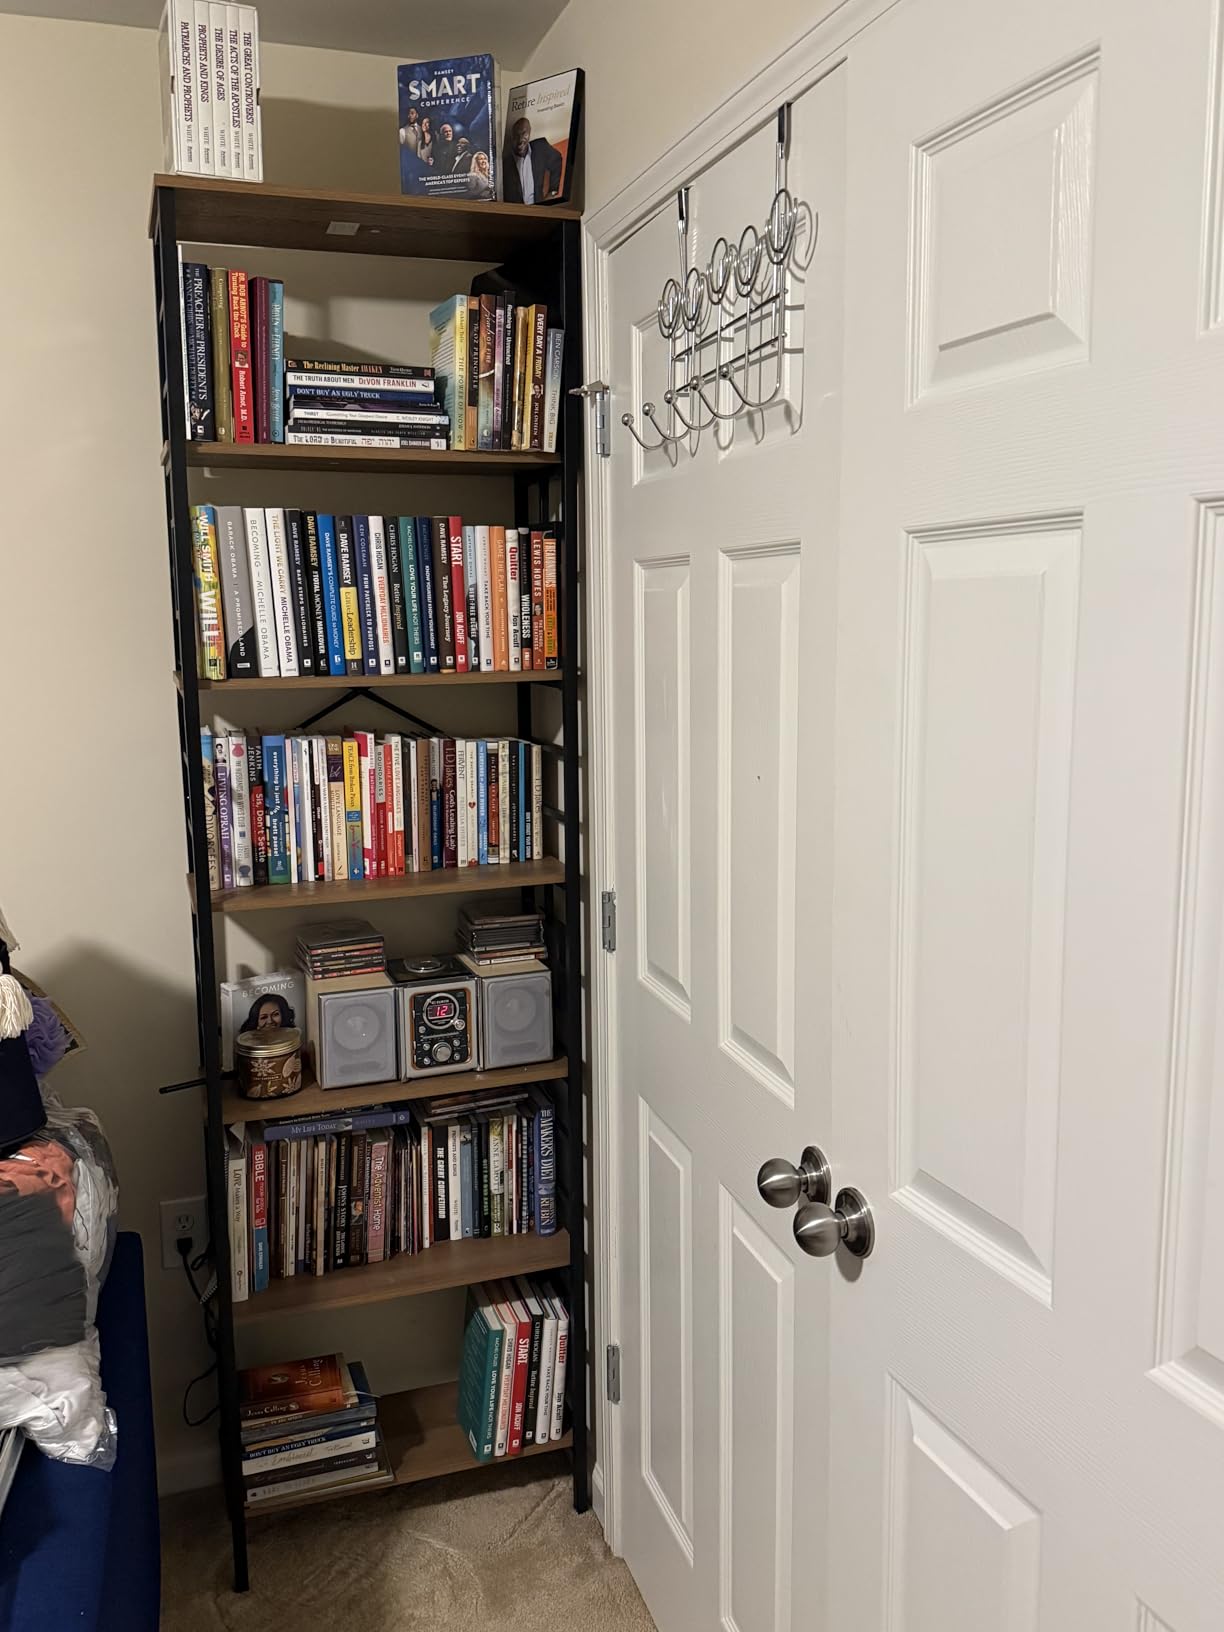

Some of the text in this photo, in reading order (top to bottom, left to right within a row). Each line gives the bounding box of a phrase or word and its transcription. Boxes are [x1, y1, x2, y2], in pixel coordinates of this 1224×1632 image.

[181, 22, 191, 65] PATRIARCHS
[198, 25, 208, 61] PROPHETS
[215, 28, 223, 42] THE
[230, 30, 238, 44] THE
[244, 32, 252, 46] THE
[215, 44, 224, 68] DESIRE
[230, 46, 238, 64] ACTS
[244, 48, 253, 71] GREAT
[183, 66, 191, 83] AND
[200, 63, 208, 79] AND
[216, 71, 224, 81] OF
[231, 66, 239, 75] OF
[201, 81, 209, 102] KINGS
[217, 82, 225, 100] AGES
[231, 77, 239, 91] THE
[408, 73, 480, 100] SMART
[184, 85, 192, 122] PROPHETS
[232, 93, 240, 128] APOSTLES
[245, 73, 254, 125] CONTROVERSY
[420, 97, 470, 107] CONFERENCE
[512, 99, 535, 111] Retire
[537, 85, 571, 105] Inspired
[553, 350, 561, 379] CARSON
[383, 379, 416, 387] FRANKLIN
[227, 521, 235, 550] BARACK
[273, 531, 281, 554] LIGHT
[275, 556, 282, 567] WE
[375, 549, 383, 570] HOGAN
[390, 547, 398, 573] HOGAN
[509, 547, 518, 581] Quitter
[199, 515, 219, 643] WILL SMITH WILL
[250, 520, 270, 659] BECOMING MICHELLE OBAMA
[276, 569, 285, 594] CARRY
[291, 522, 299, 538] DAVE
[299, 607, 308, 647] MILLIONAIRES
[307, 516, 325, 654] DAVE RAMSEY TOTAL MONEY MAKEOVER
[378, 576, 387, 604] EVERYDAY
[450, 536, 465, 644] START. JON ACUFF
[393, 584, 401, 602] Retire
[235, 598, 243, 635] PROMISED
[280, 596, 290, 634] MICHELLE
[380, 606, 389, 643] MILLIONAIRES
[394, 604, 404, 630] Inspired
[521, 594, 531, 639] WHOLENESS
[238, 637, 246, 656] LAND
[512, 628, 520, 648] Acuff
[248, 746, 256, 782] JENKINS
[445, 746, 456, 764] T.D.
[445, 764, 456, 788] Jakes
[217, 772, 230, 839] LIVING OPRAH
[255, 793, 266, 863] Sis, Don't Settle
[242, 981, 295, 998] BECOMING
[436, 1005, 448, 1016] 12
[540, 1118, 554, 1156] MAKER'S
[541, 1159, 554, 1180] DIET
[373, 1157, 384, 1230] The Adventist Home
[437, 1148, 446, 1219] THE GREAT COMPETITION
[540, 1198, 551, 1225] RUBIN
[517, 1338, 529, 1365] START.
[558, 1334, 568, 1364] Quitter
[309, 1359, 323, 1386] Calling
[513, 1414, 522, 1431] ACUFF
